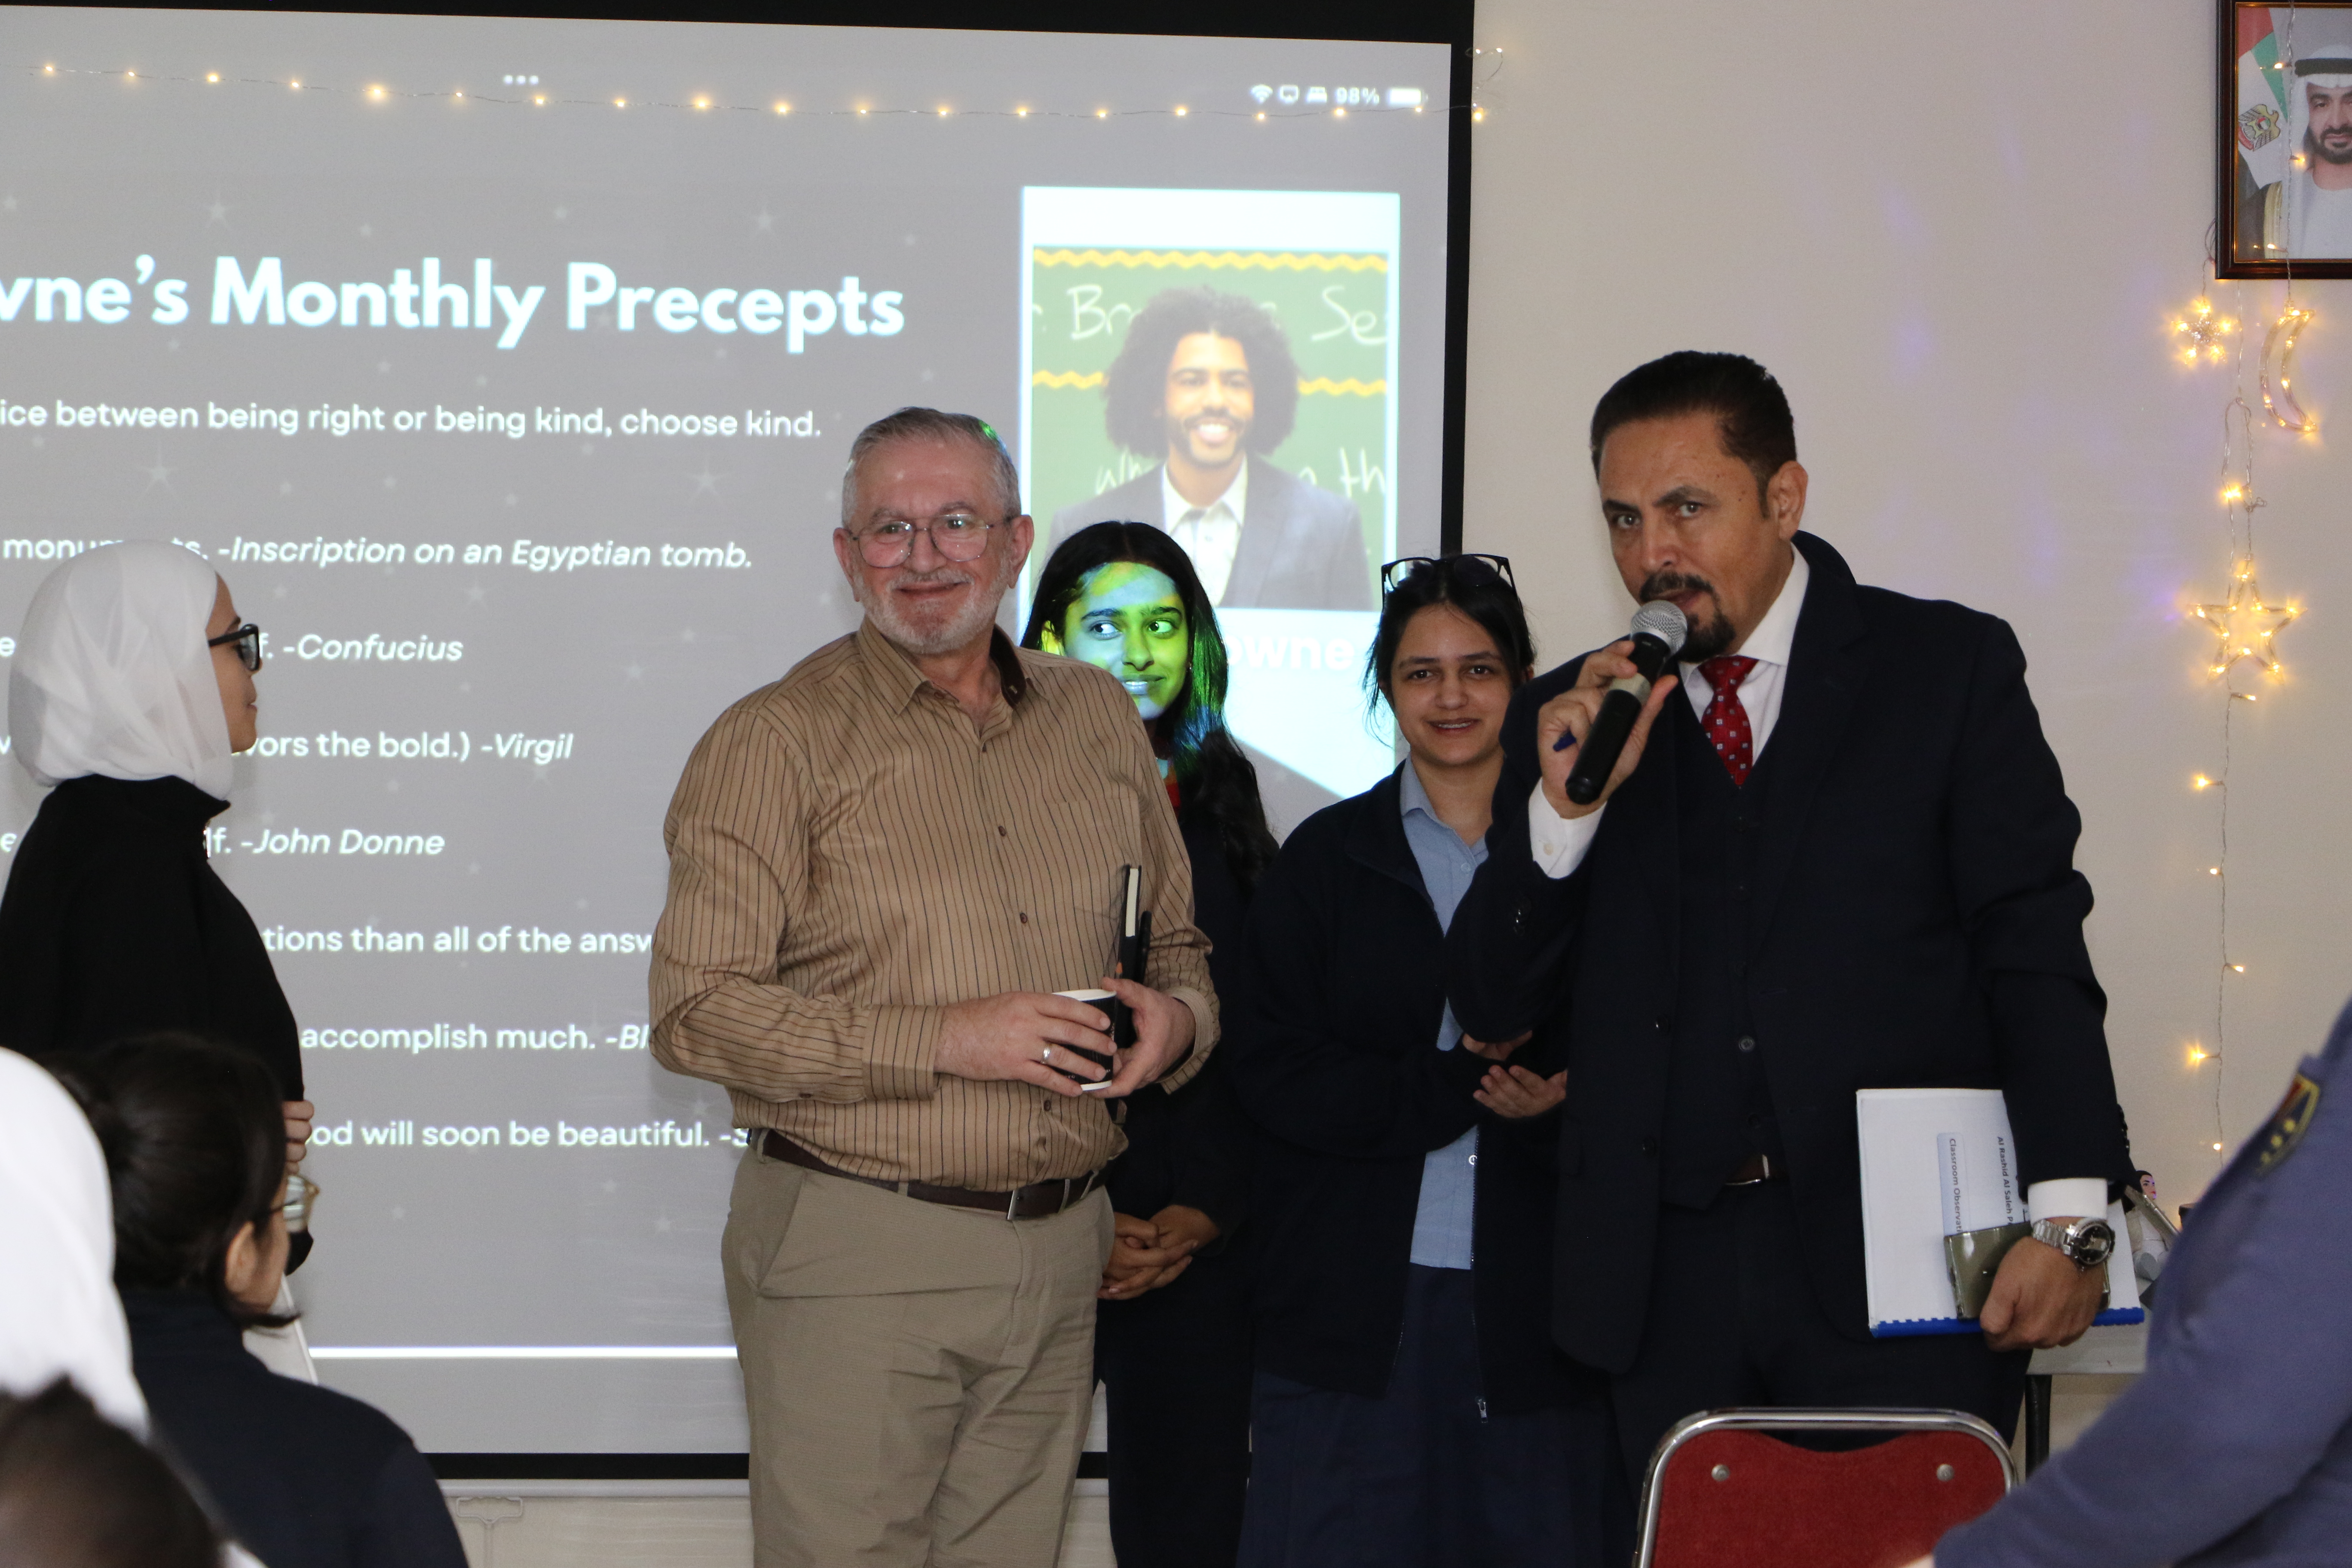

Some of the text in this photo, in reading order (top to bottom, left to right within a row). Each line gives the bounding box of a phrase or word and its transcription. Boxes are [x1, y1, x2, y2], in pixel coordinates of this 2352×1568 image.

[1334, 86, 1380, 106] 98%
[210, 255, 546, 350] Monthly
[567, 261, 905, 355] Precepts
[0, 398, 821, 440] ice between being right or being kind, choose kind.
[218, 536, 406, 569] -Inscription
[413, 543, 455, 564] on
[462, 544, 502, 565] an
[511, 539, 651, 573] Egyptian
[660, 541, 752, 569] tomb.
[282, 633, 464, 662] -Confucius
[315, 730, 371, 758] the
[378, 731, 471, 763] bold.)
[481, 732, 575, 766] -Virgil
[240, 827, 331, 854] -John
[339, 828, 446, 855] Donne
[262, 925, 343, 952] tions
[349, 925, 424, 952] than
[433, 925, 469, 952] all
[476, 925, 512, 953] of
[516, 926, 572, 954] the
[300, 1023, 487, 1055] accomplish
[496, 1023, 596, 1050] much.
[360, 1120, 413, 1145] will
[422, 1126, 500, 1147] soon
[509, 1120, 551, 1147] be
[557, 1120, 710, 1148] beautiful.
[1949, 1139, 1958, 1185] Classroom
[1999, 1148, 2009, 1176] Rashid
[2004, 1190, 2013, 1214] Saleh
